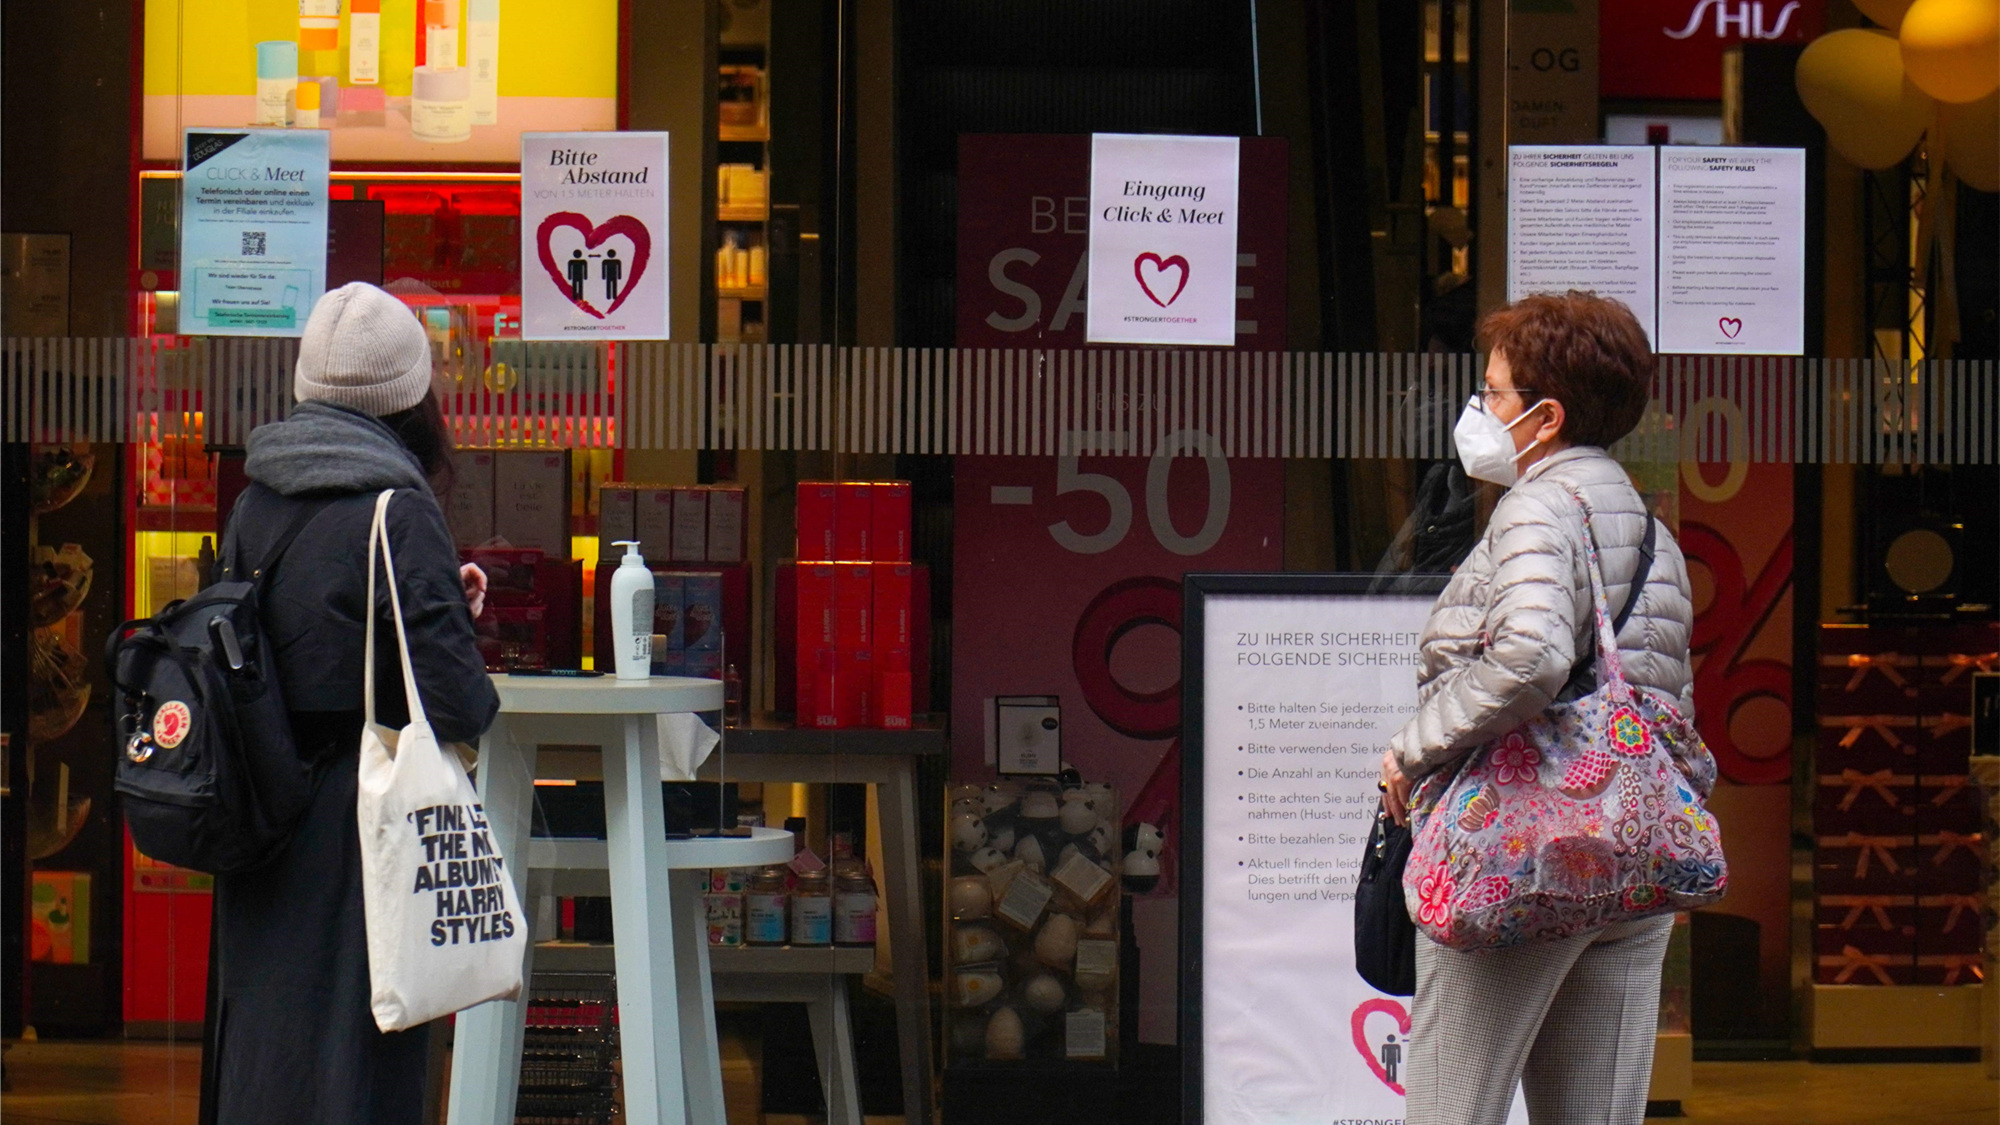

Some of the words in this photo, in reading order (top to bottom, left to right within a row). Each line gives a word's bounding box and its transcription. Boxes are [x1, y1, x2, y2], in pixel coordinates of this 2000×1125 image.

[1530, 47, 1580, 72] OG
[550, 149, 598, 166] Bitte
[206, 167, 247, 181] CLICK
[250, 168, 260, 180] &
[264, 167, 305, 182] Meet
[561, 166, 648, 184] Abstand
[201, 187, 242, 195] Telefonisch
[244, 188, 262, 196] oder
[264, 188, 287, 196] online
[578, 189, 612, 198] METER
[614, 189, 655, 198] HALTEN
[1123, 180, 1206, 202] Eingang
[196, 197, 221, 205] Termin
[223, 198, 268, 206] vereinbaren
[1104, 206, 1152, 223] Click
[1156, 208, 1172, 222] &
[1178, 208, 1224, 224] Meet
[990, 429, 1231, 556] -50
[1237, 632, 1259, 646] ZU
[1266, 632, 1314, 646] IHRER
[1320, 632, 1420, 646] SICHERHEIT
[1237, 652, 1331, 666] FOLGENDE
[1247, 702, 1276, 714] Bitte
[1279, 702, 1316, 714] halten
[1320, 702, 1338, 714] Sie
[1341, 702, 1394, 716] jederzeit
[1249, 718, 1265, 731] 1,5
[1269, 718, 1304, 730] Meter
[1308, 718, 1378, 730] zueinander.
[1247, 743, 1276, 754] Bitte
[1279, 743, 1346, 754] verwenden
[1350, 743, 1369, 754] Sie
[1247, 768, 1268, 779] Die
[1271, 768, 1313, 779] Anzahl
[1316, 770, 1331, 779] an
[1334, 768, 1381, 779] Kunden
[1247, 793, 1276, 804] Bitte
[1279, 792, 1320, 804] achten
[1324, 793, 1342, 804] Sie
[1346, 792, 1364, 804] auf
[1248, 809, 1297, 820] nahmen
[1300, 809, 1335, 821] (Hust-
[1339, 809, 1362, 820] und
[1248, 834, 1276, 844] Bitte
[1280, 833, 1334, 844] bezahlen
[1338, 834, 1356, 844] Sie
[421, 833, 468, 862] THE
[1247, 858, 1290, 869] Aktuell
[1294, 858, 1332, 869] finden
[413, 859, 493, 894] ALBUM
[1248, 874, 1275, 885] Dies
[1278, 874, 1320, 885] betrifft
[1324, 874, 1347, 885] den
[436, 884, 504, 917] HARRY
[1248, 889, 1290, 904] lungen
[1294, 889, 1317, 901] und
[430, 912, 514, 946] STYLES
